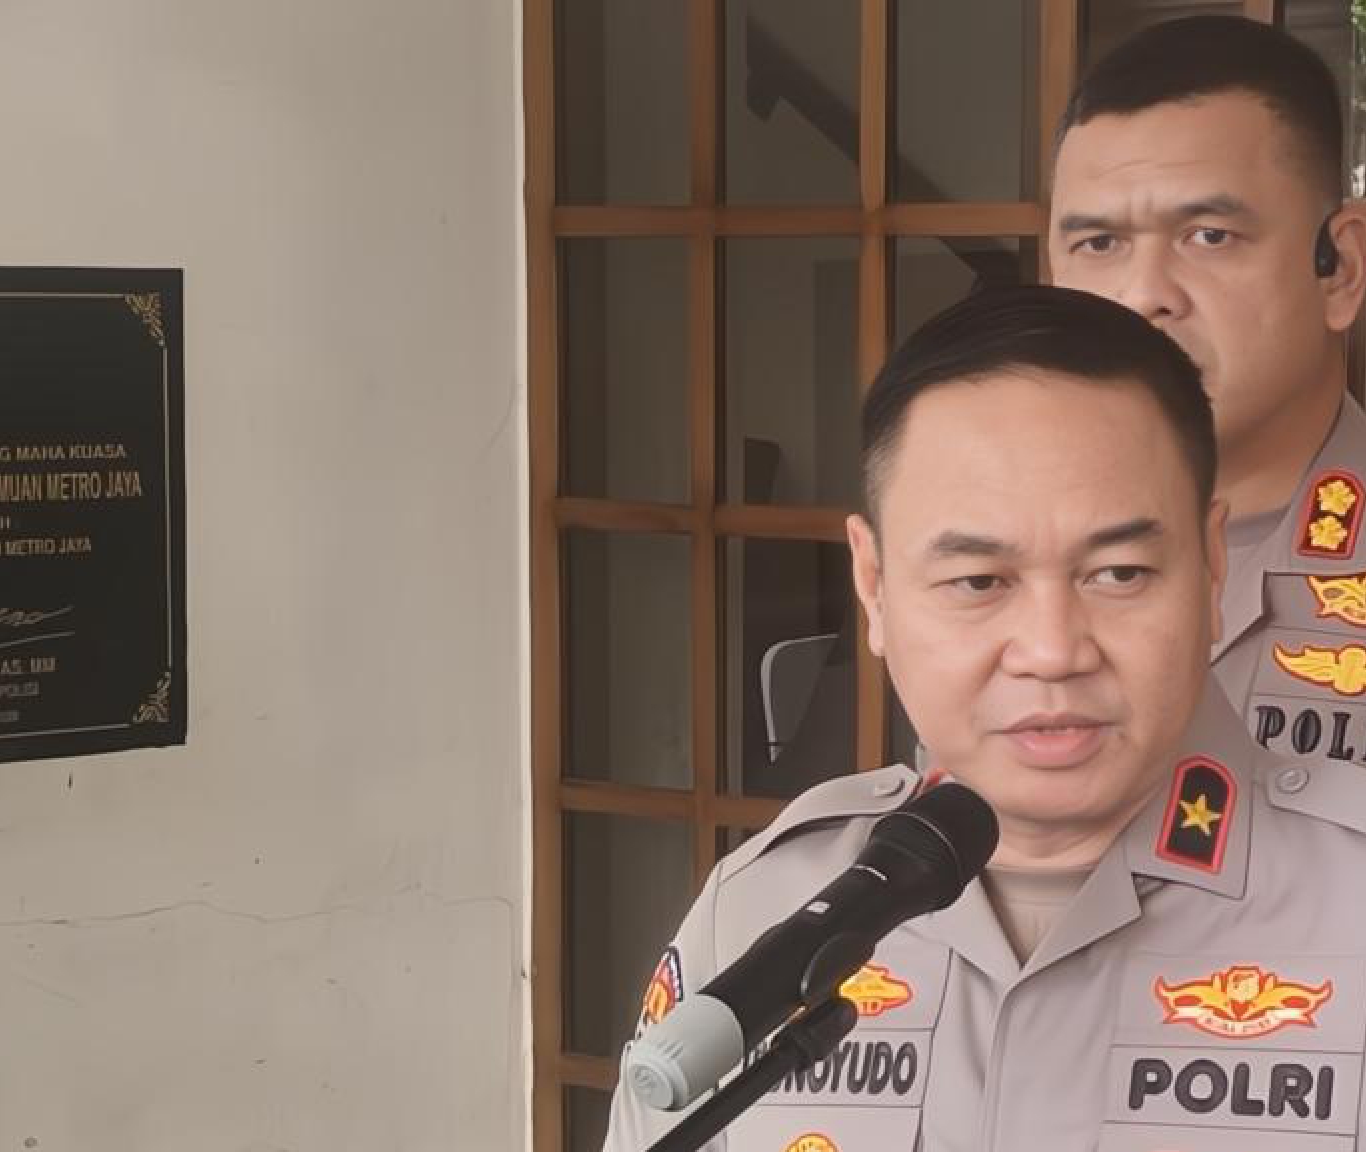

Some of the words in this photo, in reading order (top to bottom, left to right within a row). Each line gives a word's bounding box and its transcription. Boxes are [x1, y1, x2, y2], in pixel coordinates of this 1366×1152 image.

[16, 445, 66, 461] MAHA
[68, 443, 127, 460] KUASA
[46, 471, 102, 501] METRO
[106, 470, 142, 498] JAYA
[4, 539, 56, 555] METRO
[58, 537, 92, 553] JAYA
[1128, 1057, 1334, 1121] POLRI
